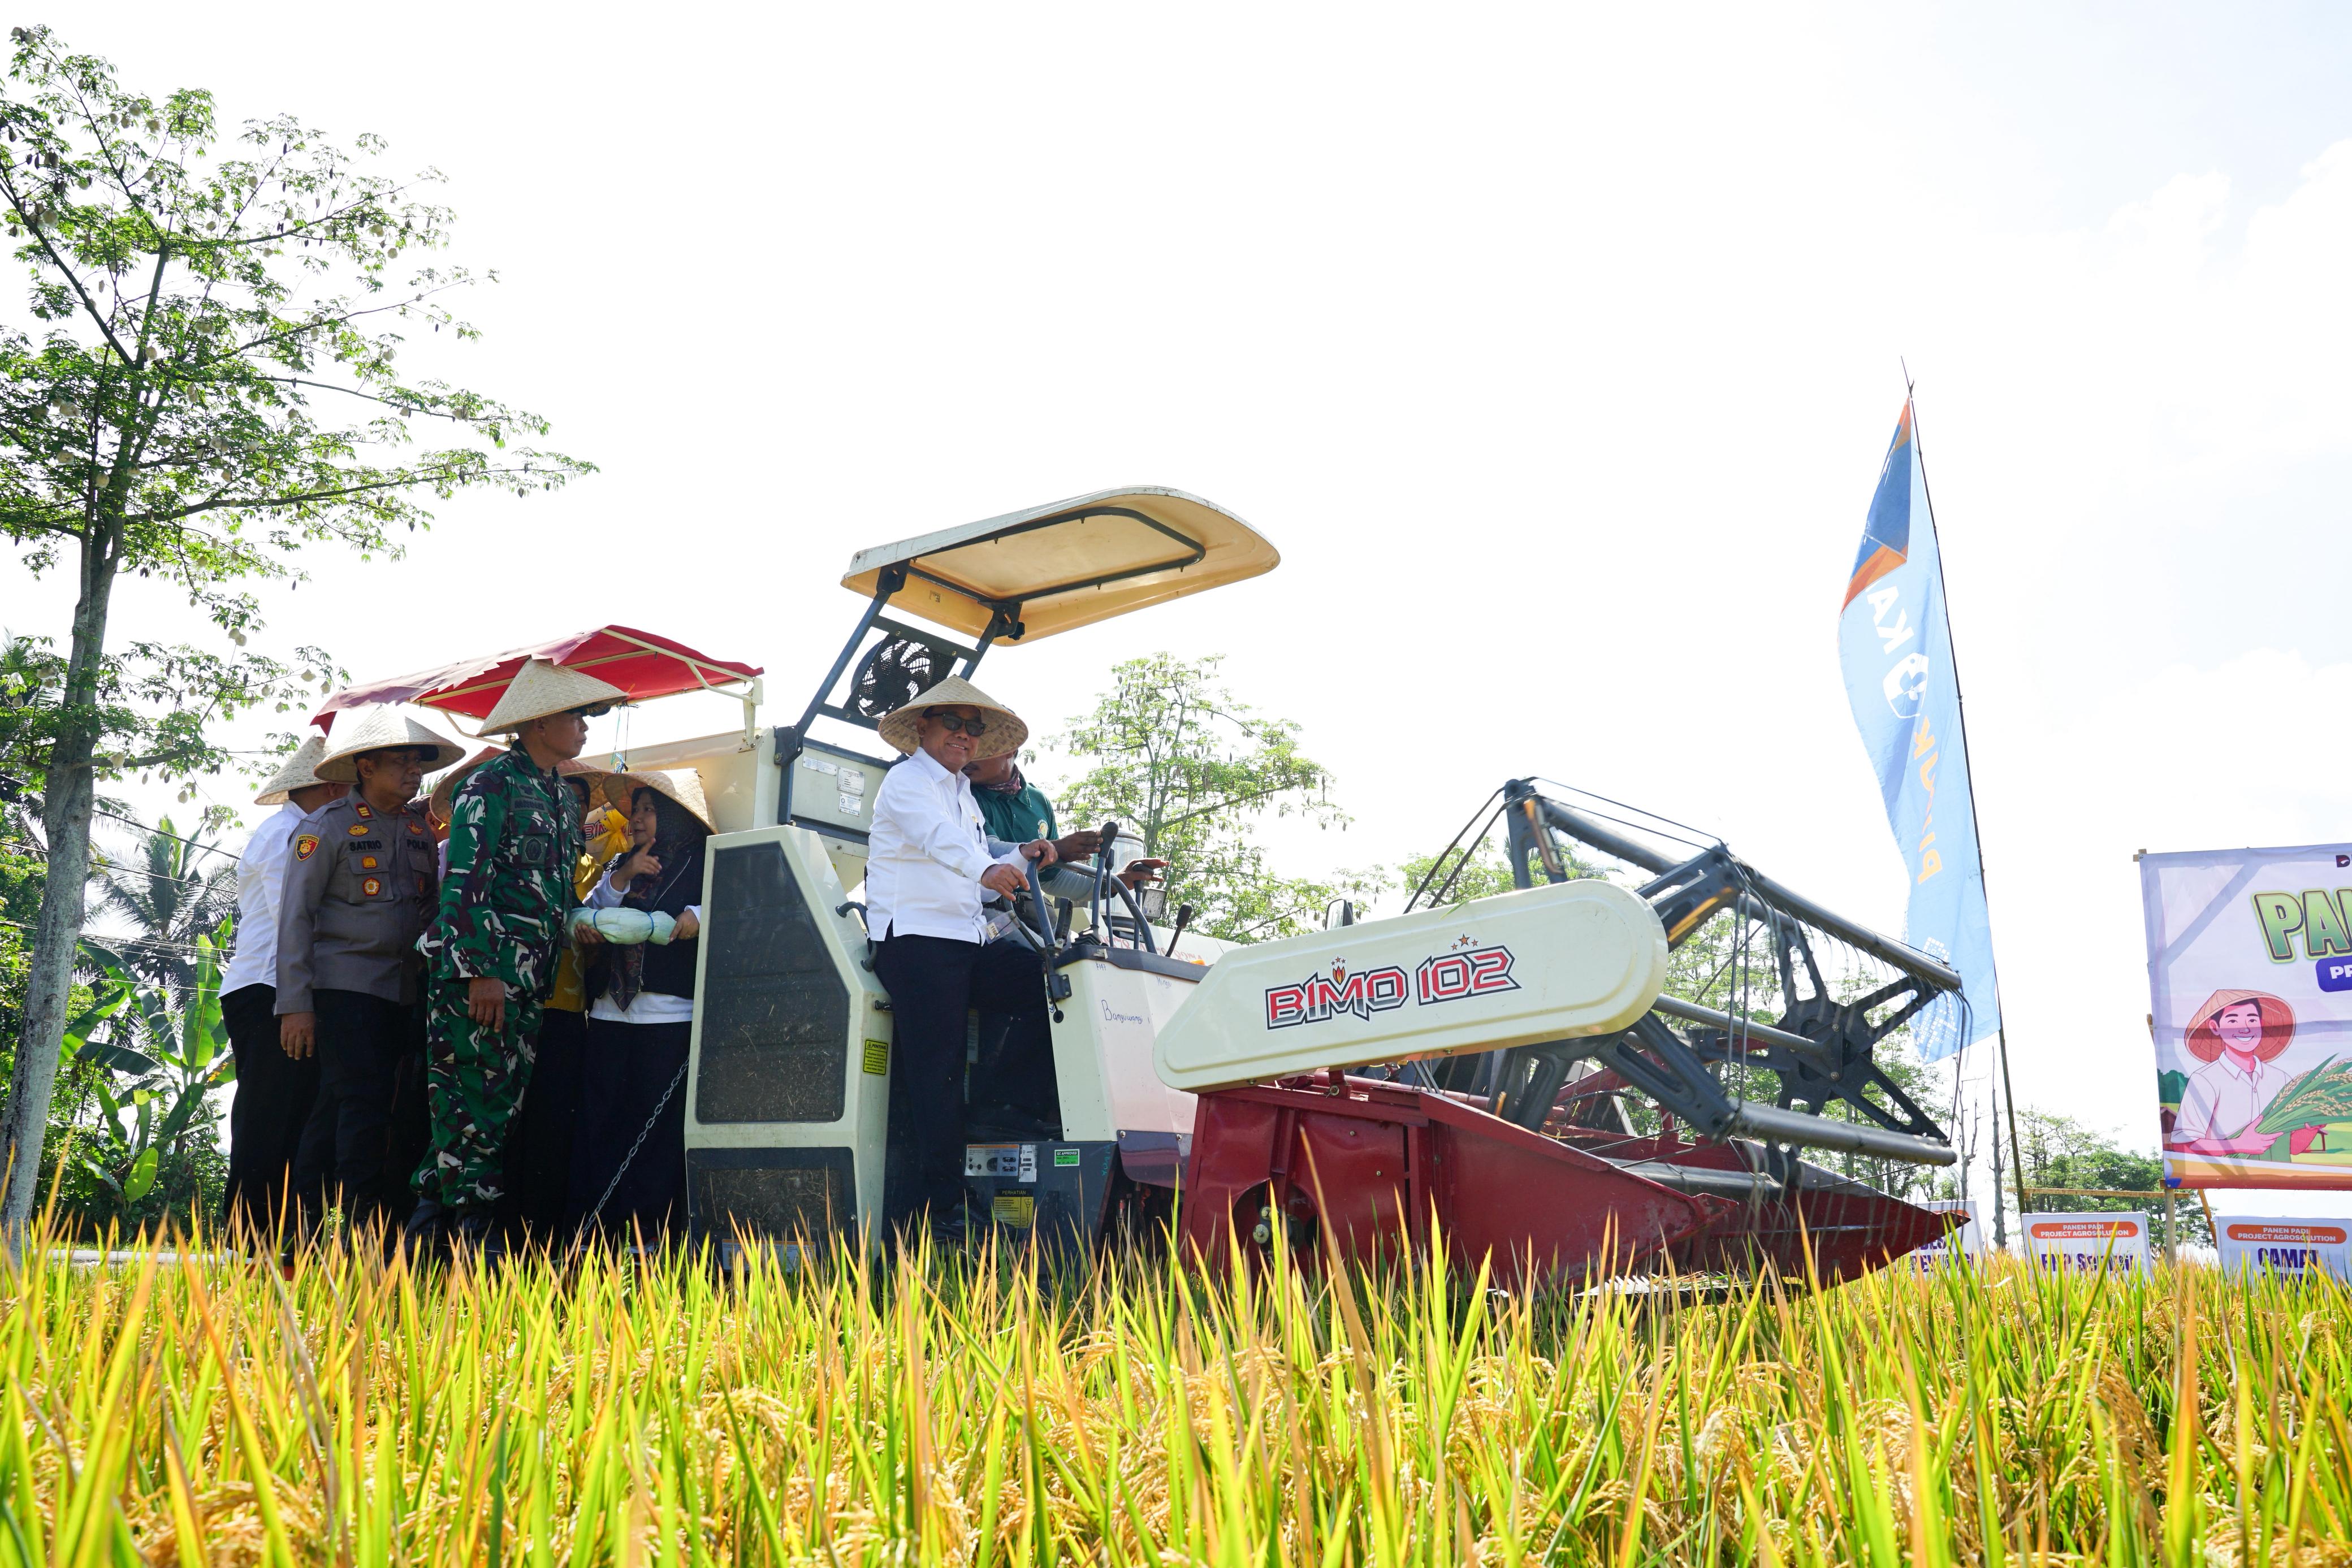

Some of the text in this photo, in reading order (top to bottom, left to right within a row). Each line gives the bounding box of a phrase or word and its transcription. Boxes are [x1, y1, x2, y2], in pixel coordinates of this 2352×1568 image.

[349, 839, 382, 851] SATRIO
[1265, 945, 1523, 1030] BIMO 102
[2273, 1233, 2336, 1242] AGROSOLUTION
